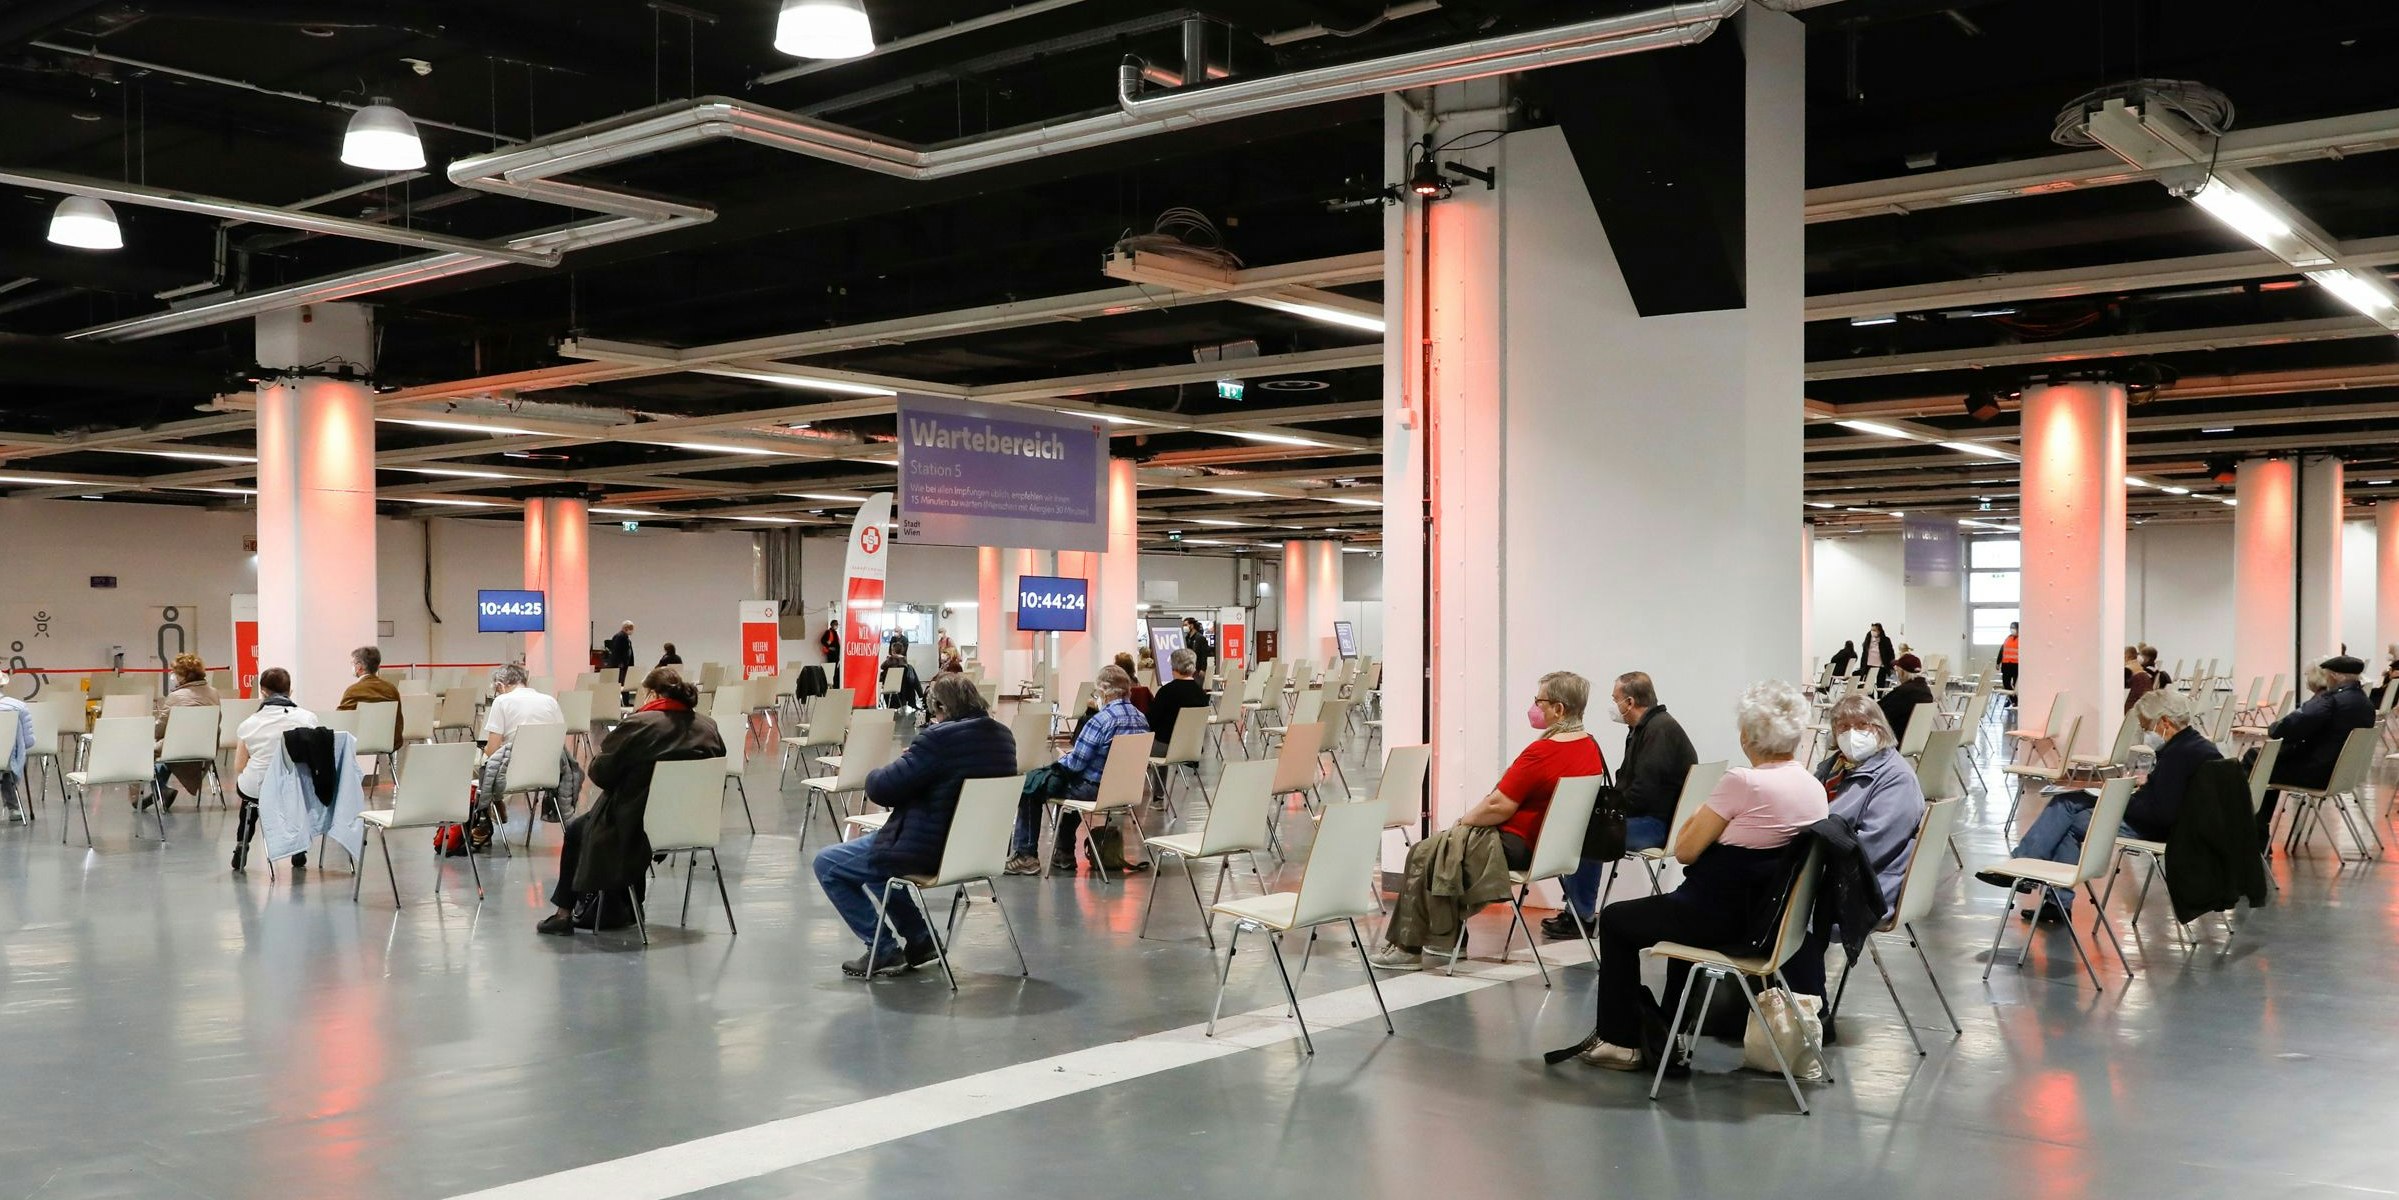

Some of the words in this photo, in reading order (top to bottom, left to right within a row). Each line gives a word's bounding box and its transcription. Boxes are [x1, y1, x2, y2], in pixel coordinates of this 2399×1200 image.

[910, 418, 1065, 460] Wartebereich
[911, 460, 952, 477] Station
[955, 464, 962, 478] 5
[911, 495, 919, 505] 15
[920, 496, 949, 506] Minuten
[950, 499, 959, 507] zu
[925, 484, 937, 494] bei
[954, 486, 990, 499] Impfungen
[1011, 490, 1043, 502] empfehlen
[904, 520, 920, 528] Stadt
[904, 528, 920, 536] Wien
[479, 602, 542, 615] 10:44:25
[1020, 591, 1085, 610] 10:44:24
[1156, 632, 1180, 650] WC
